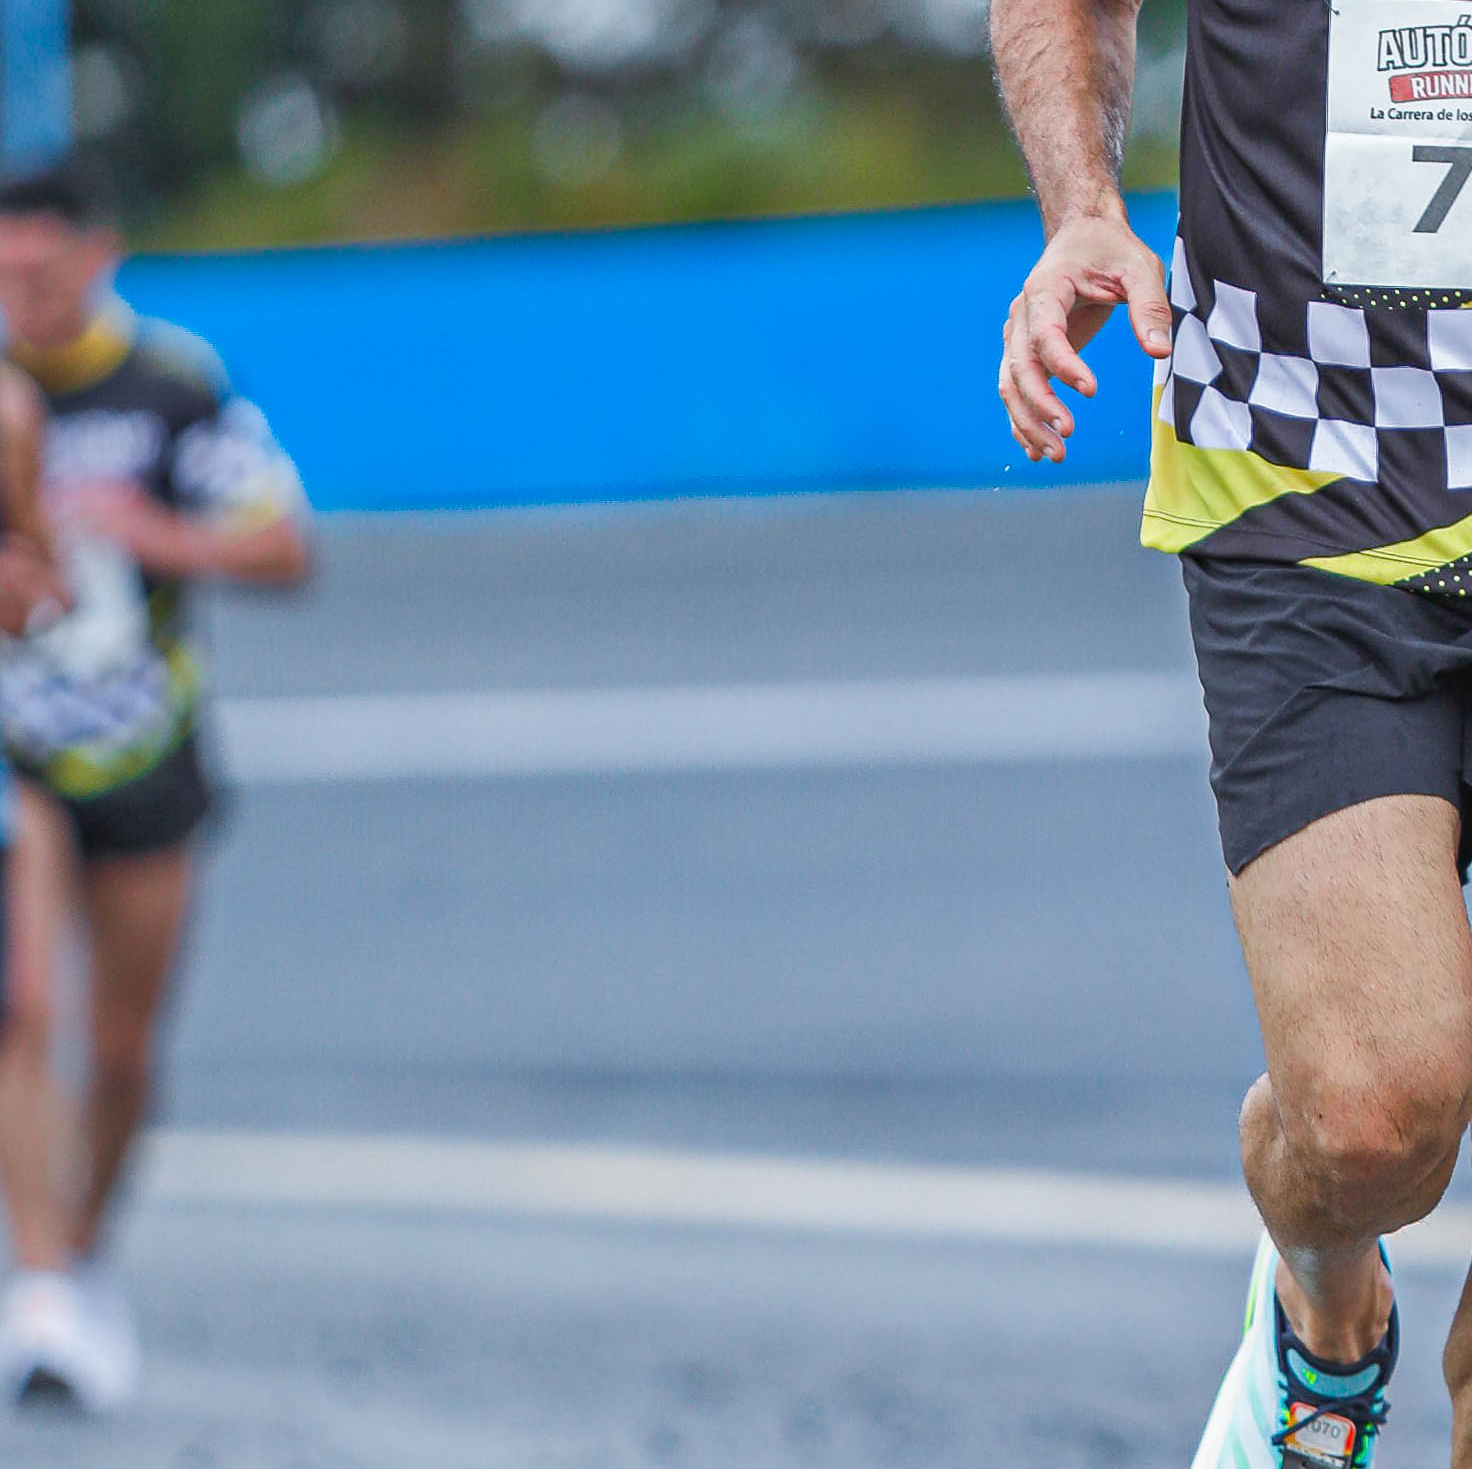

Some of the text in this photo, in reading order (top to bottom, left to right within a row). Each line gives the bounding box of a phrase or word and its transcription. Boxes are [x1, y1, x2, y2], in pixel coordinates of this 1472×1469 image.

[1371, 107, 1384, 119] La
[1388, 108, 1433, 120] Carrera
[1435, 108, 1453, 121] de
